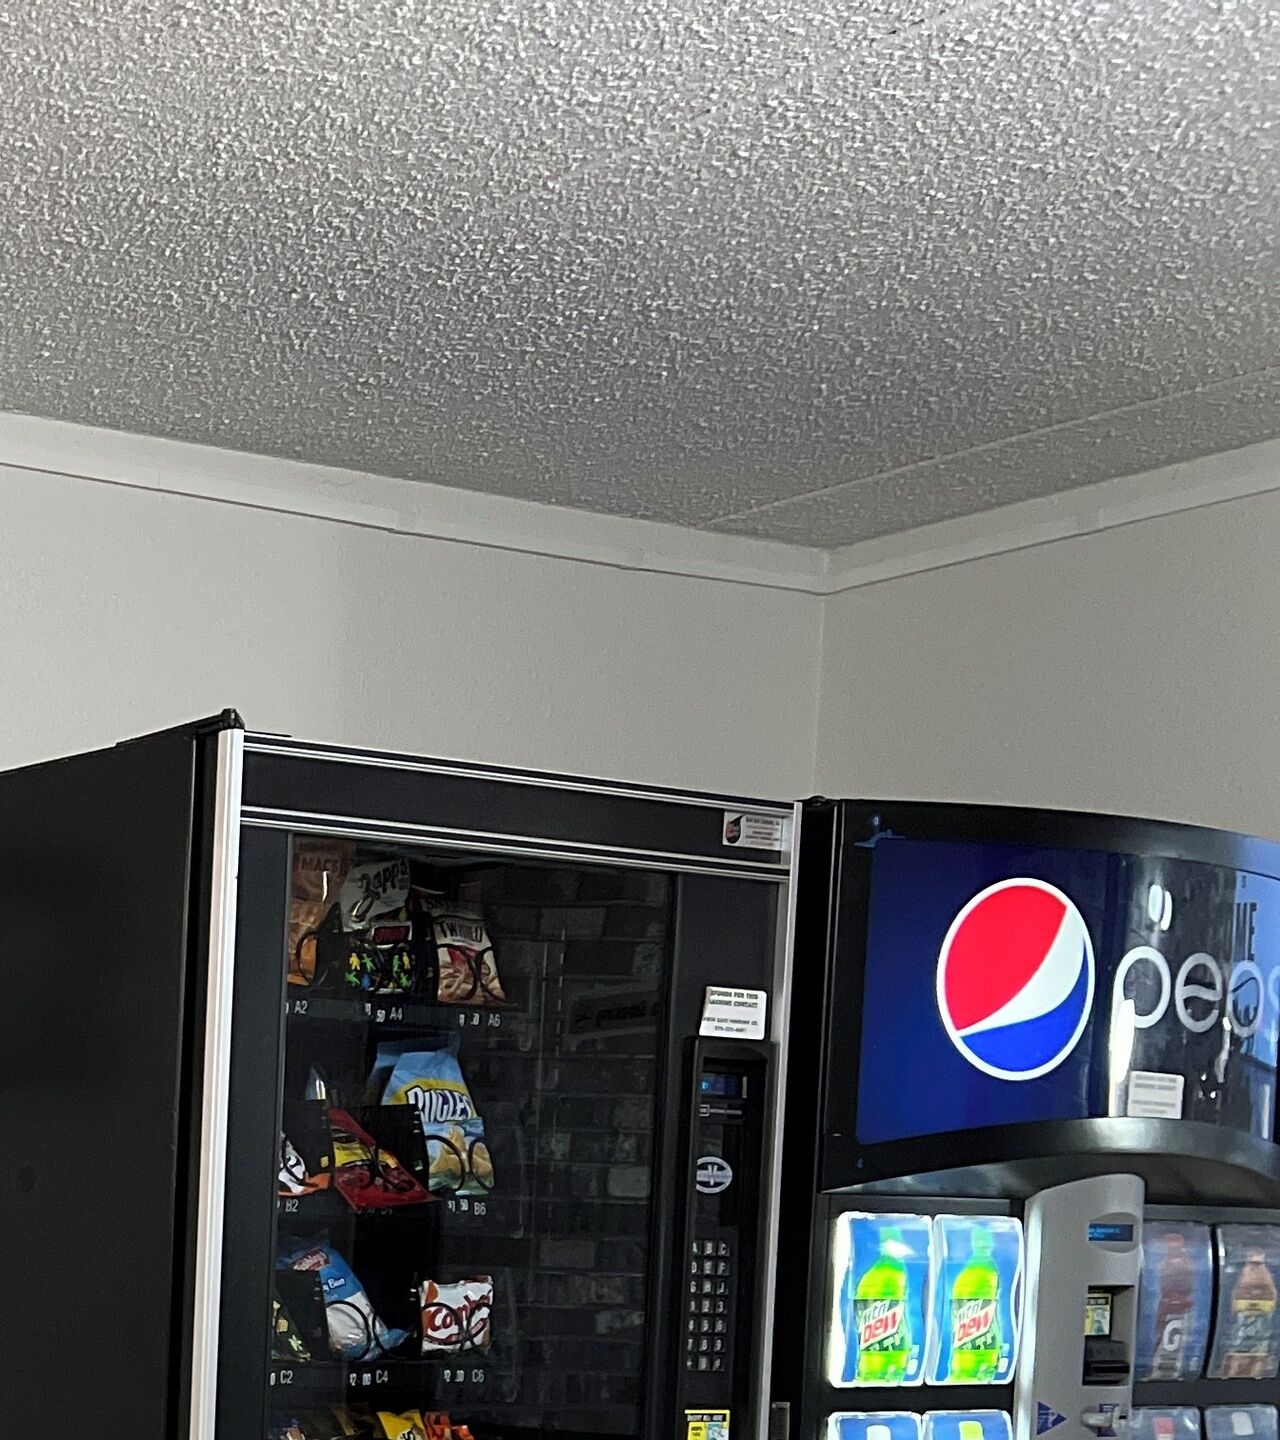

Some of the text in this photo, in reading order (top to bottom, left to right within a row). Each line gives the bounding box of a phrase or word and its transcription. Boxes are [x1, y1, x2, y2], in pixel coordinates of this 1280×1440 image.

[294, 1000, 308, 1014] A2
[390, 1007, 403, 1020] A4
[488, 1013, 501, 1027] A6
[285, 1199, 298, 1213] B2
[474, 1202, 487, 1216] B6
[1163, 1317, 1183, 1351] G
[280, 1370, 294, 1384] C2
[376, 1370, 389, 1384] C4
[471, 1369, 485, 1383] C6
